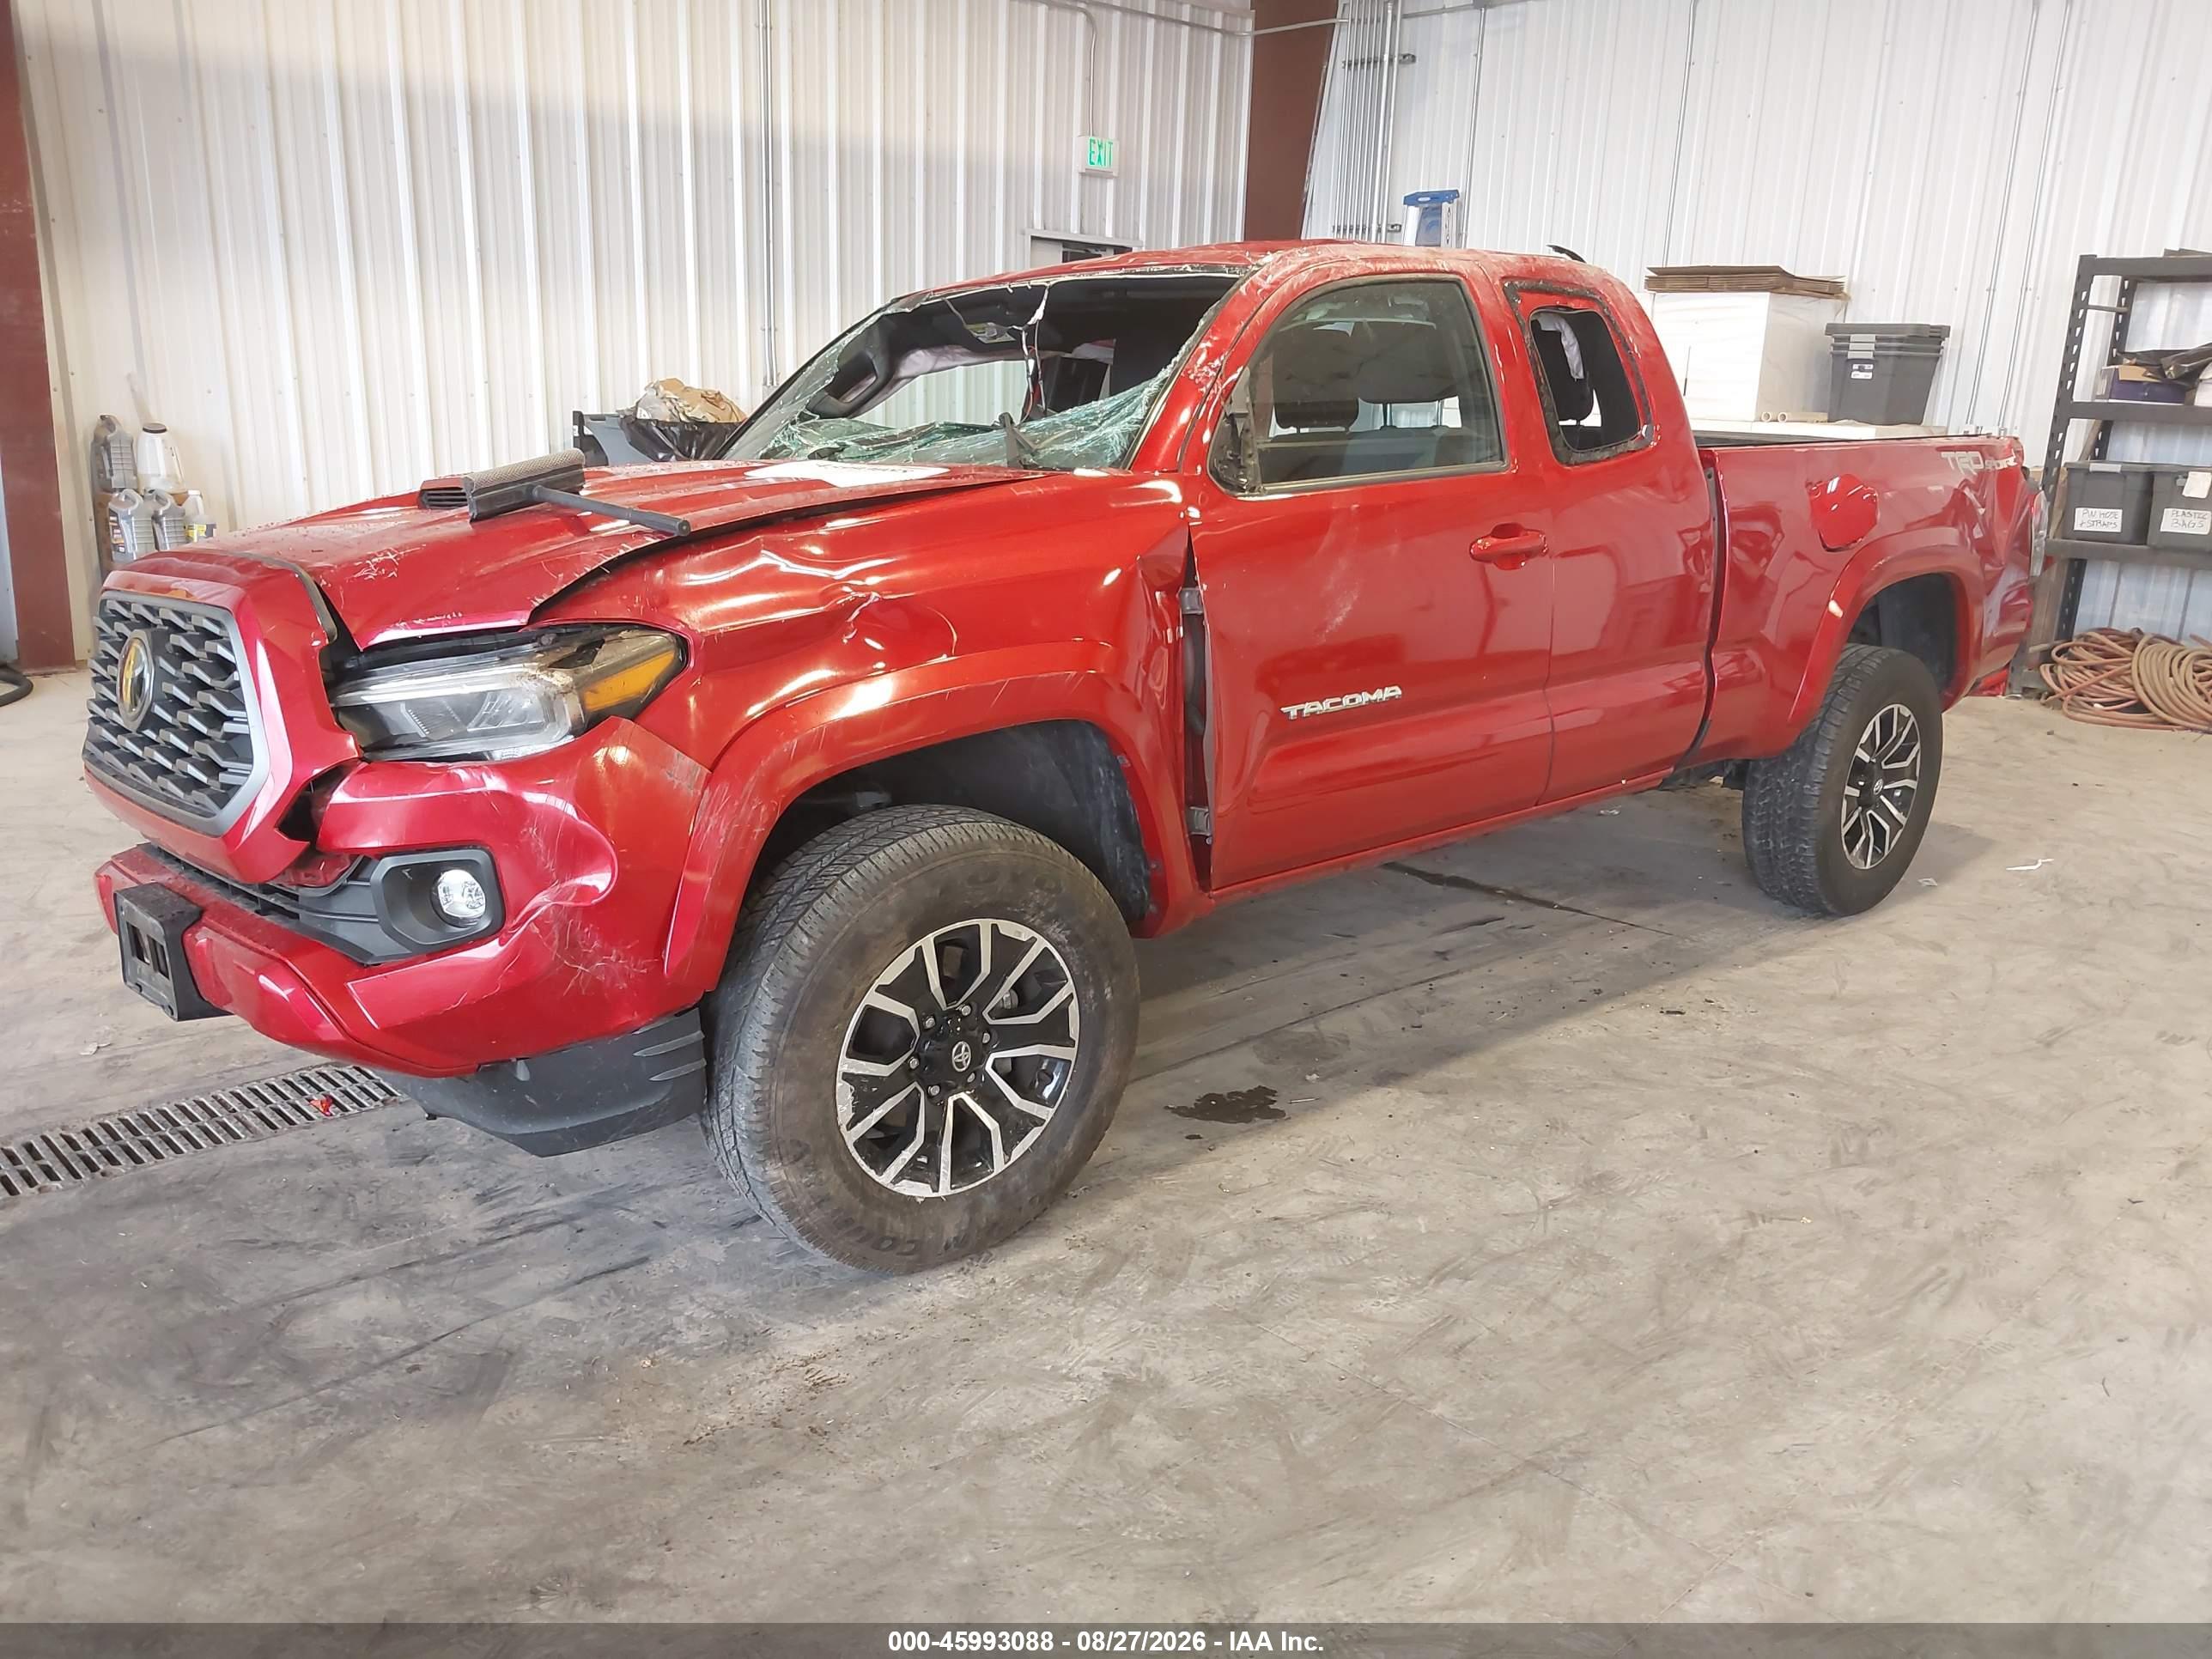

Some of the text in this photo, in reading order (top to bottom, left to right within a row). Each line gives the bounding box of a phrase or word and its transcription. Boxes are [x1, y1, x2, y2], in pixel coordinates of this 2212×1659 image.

[1089, 137, 1114, 167] EXIT
[1941, 451, 1984, 475] TRD
[2171, 509, 2208, 520] PLASTIC
[2171, 519, 2204, 529] BAGS
[1279, 685, 1402, 720] TACOMA
